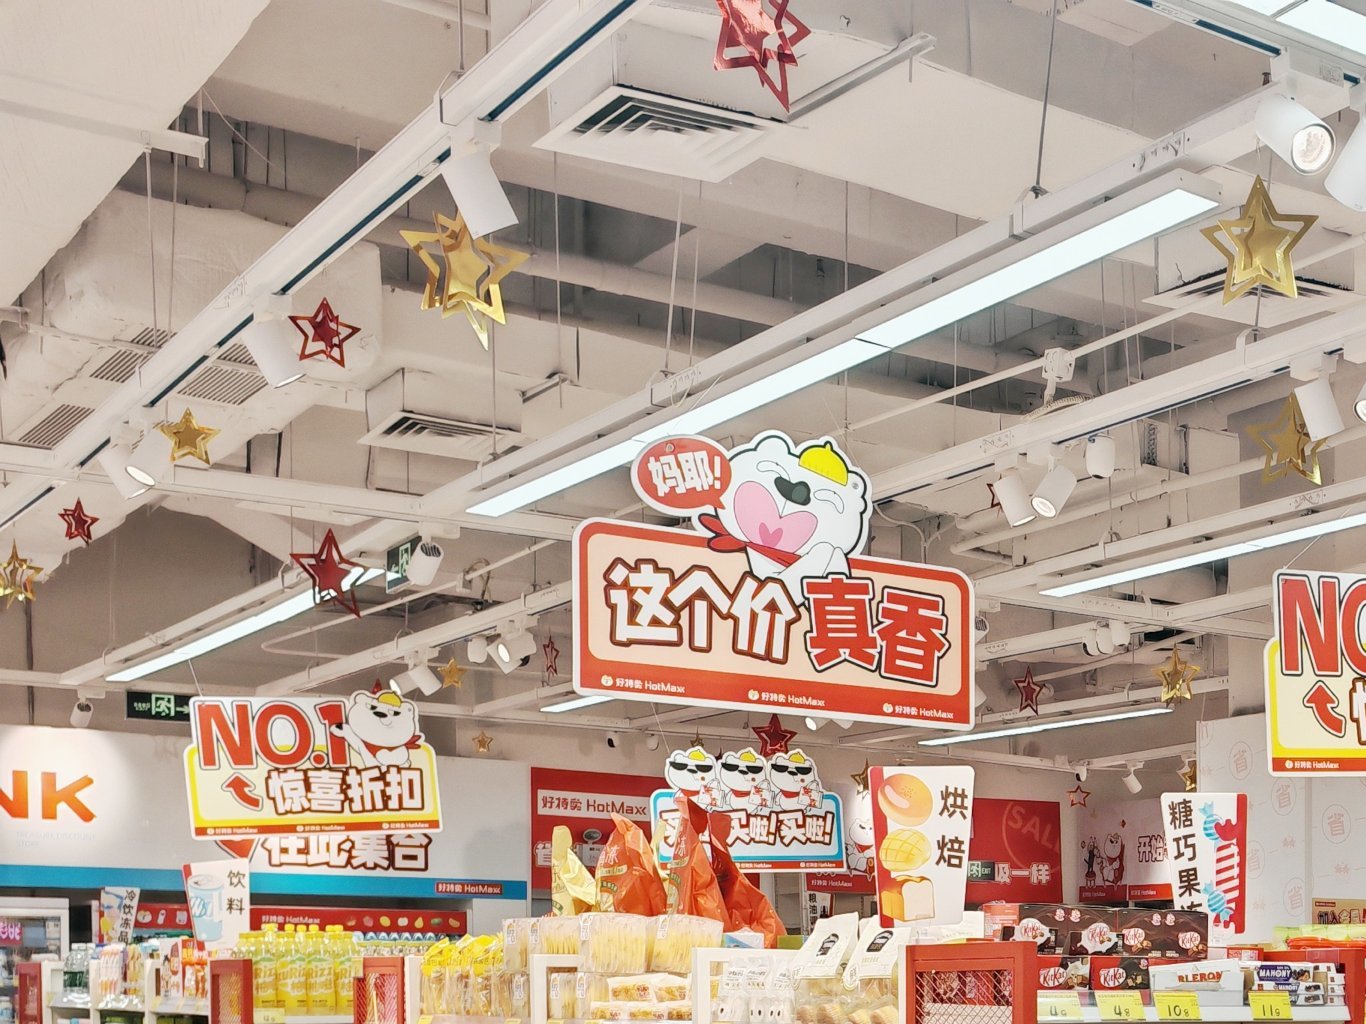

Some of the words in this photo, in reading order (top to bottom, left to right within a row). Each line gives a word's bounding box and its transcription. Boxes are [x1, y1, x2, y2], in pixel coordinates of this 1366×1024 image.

[646, 450, 722, 497] 妈耶!
[606, 560, 950, 687] 这个价真香
[196, 702, 351, 768] NO.1
[267, 766, 425, 815] 惊喜折扣
[586, 799, 647, 816] HotMaxx
[936, 785, 968, 870] 烘焙
[1138, 835, 1168, 863] 开始
[226, 870, 247, 915] 饮料
[118, 889, 137, 944] 冷饮冻品
[1042, 969, 1066, 986] KitKat
[1103, 970, 1125, 986] KitKat
[1259, 969, 1291, 978] MAHONY
